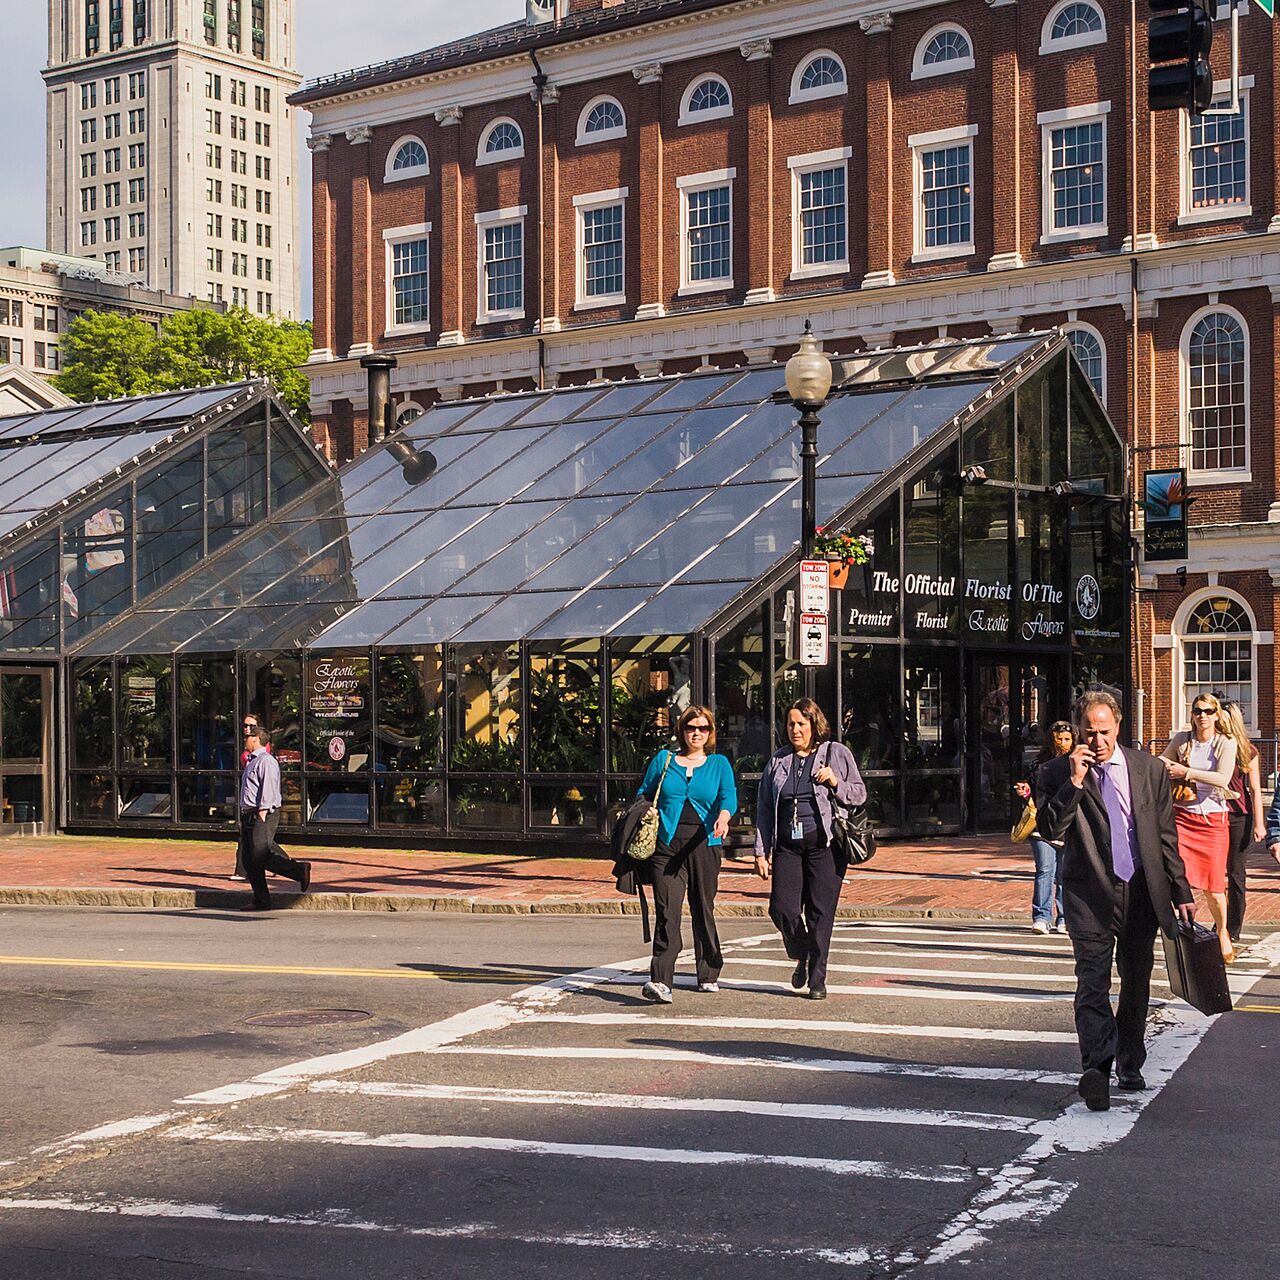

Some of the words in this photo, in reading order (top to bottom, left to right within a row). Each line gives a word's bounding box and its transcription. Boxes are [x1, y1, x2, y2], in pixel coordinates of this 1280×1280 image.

[872, 571, 899, 593] The
[904, 573, 956, 597] Official
[964, 578, 1013, 600] Florist
[1022, 583, 1040, 602] Of
[1040, 584, 1063, 604] The
[848, 608, 893, 627] Premier
[915, 611, 949, 629] Florist
[968, 609, 1010, 632] Exotic
[1021, 612, 1065, 641] Flowers
[315, 663, 356, 678] Exotic
[313, 677, 360, 693] Flowers
